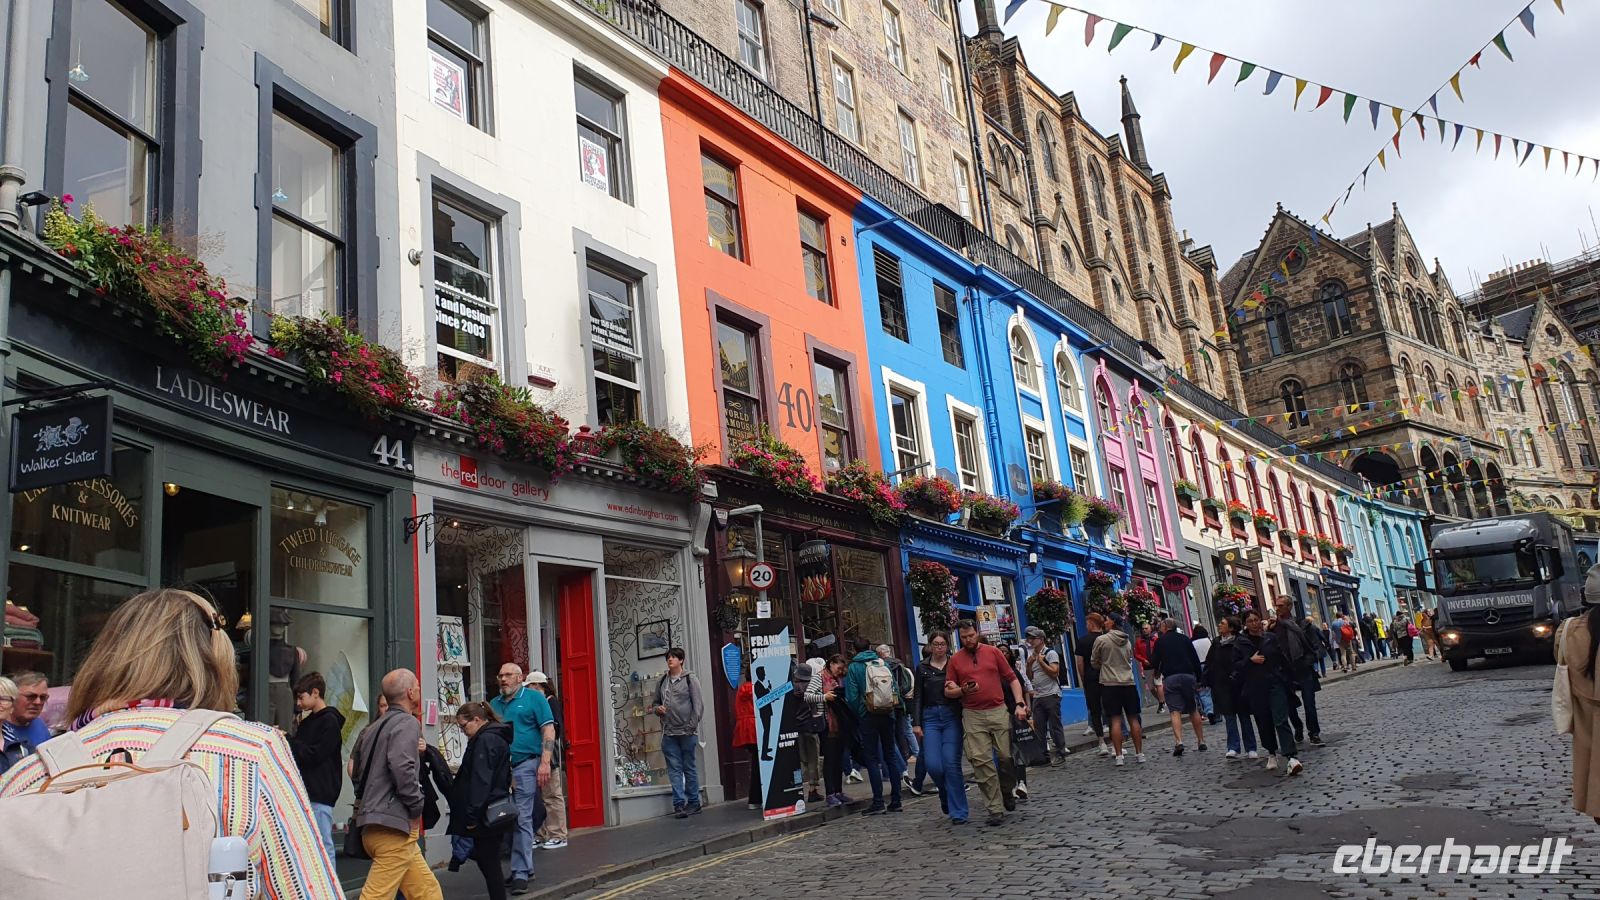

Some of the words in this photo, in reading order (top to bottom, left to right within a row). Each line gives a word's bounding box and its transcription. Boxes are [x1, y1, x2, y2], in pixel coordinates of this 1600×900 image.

[441, 297, 460, 314] and
[460, 302, 493, 326] Design
[461, 318, 486, 339] 2003
[156, 366, 291, 434] LADIESWEAR
[777, 382, 811, 433] 40
[726, 418, 750, 430] AMOUS
[21, 457, 62, 474] Walker
[64, 450, 98, 465] Slater
[441, 463, 460, 479] the
[460, 468, 478, 484] red
[480, 475, 507, 489] door
[511, 481, 549, 501] gallery
[68, 478, 138, 528] CESSORIES
[78, 490, 89, 504] &
[52, 504, 111, 531] KNITWEAR
[606, 502, 679, 522] www.edinburghart.com
[279, 527, 316, 554] TWEED
[752, 570, 772, 582] 20
[1447, 597, 1495, 610] INVERARITY
[1497, 593, 1533, 606] MORTON
[750, 634, 781, 647] FRANK
